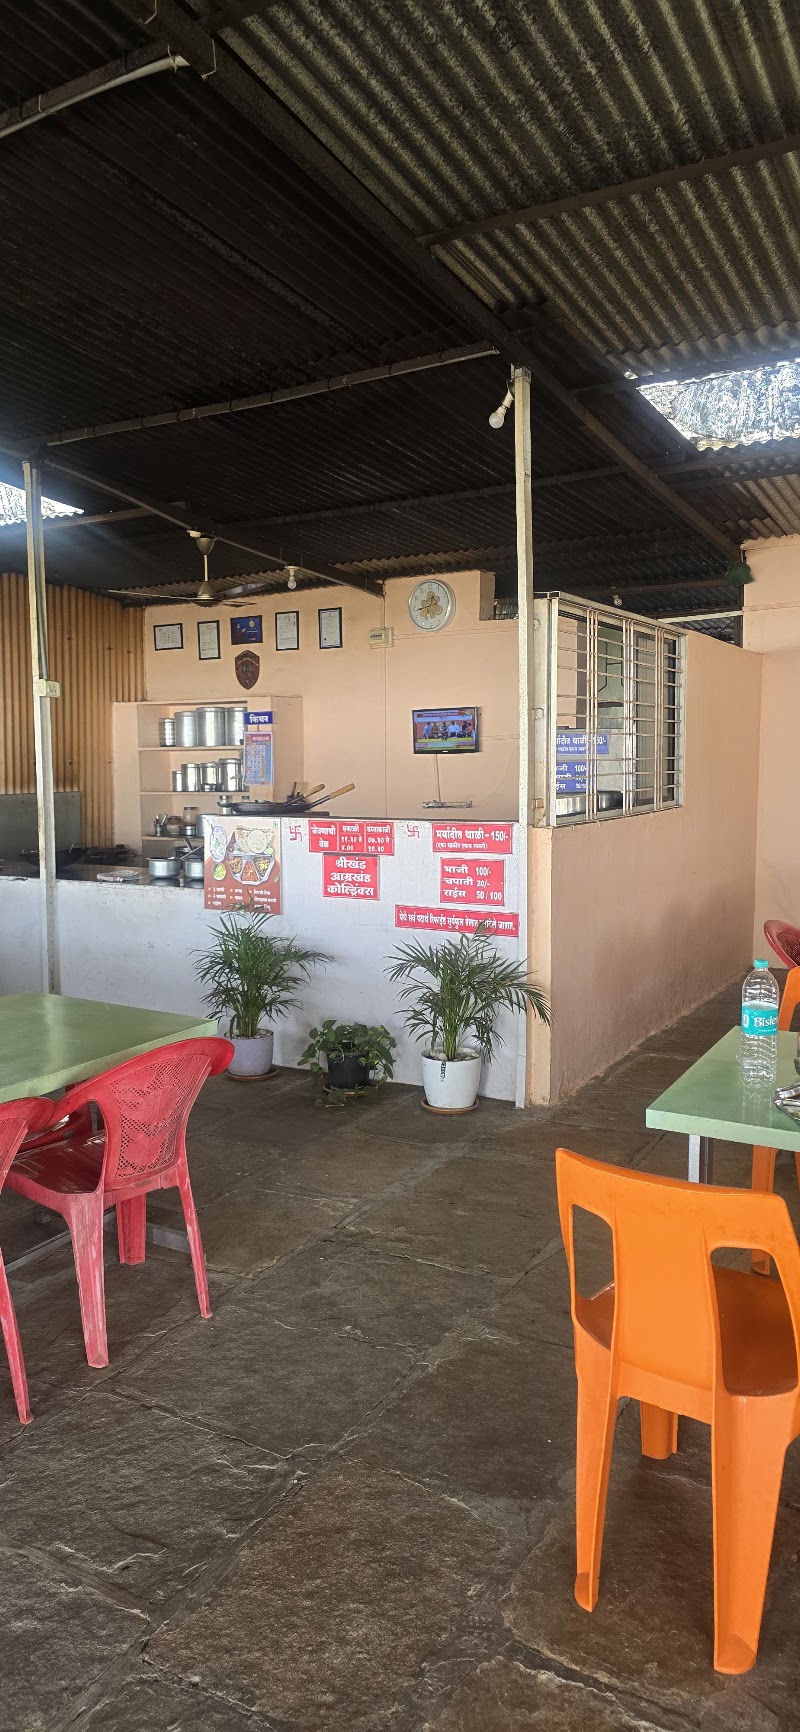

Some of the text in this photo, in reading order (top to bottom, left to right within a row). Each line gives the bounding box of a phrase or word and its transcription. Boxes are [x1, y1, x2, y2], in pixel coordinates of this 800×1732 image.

[250, 714, 268, 724] किचन
[436, 827, 462, 840] मर्यादीत
[465, 828, 484, 839] थाळी
[491, 830, 508, 841] 150/-
[318, 838, 329, 848] वेळ
[336, 856, 366, 869] श्रीखंड
[444, 864, 468, 874] भाजी
[331, 870, 372, 882] आम्रखंड
[443, 876, 490, 888] चपाती 20/-
[443, 887, 466, 898] राईस
